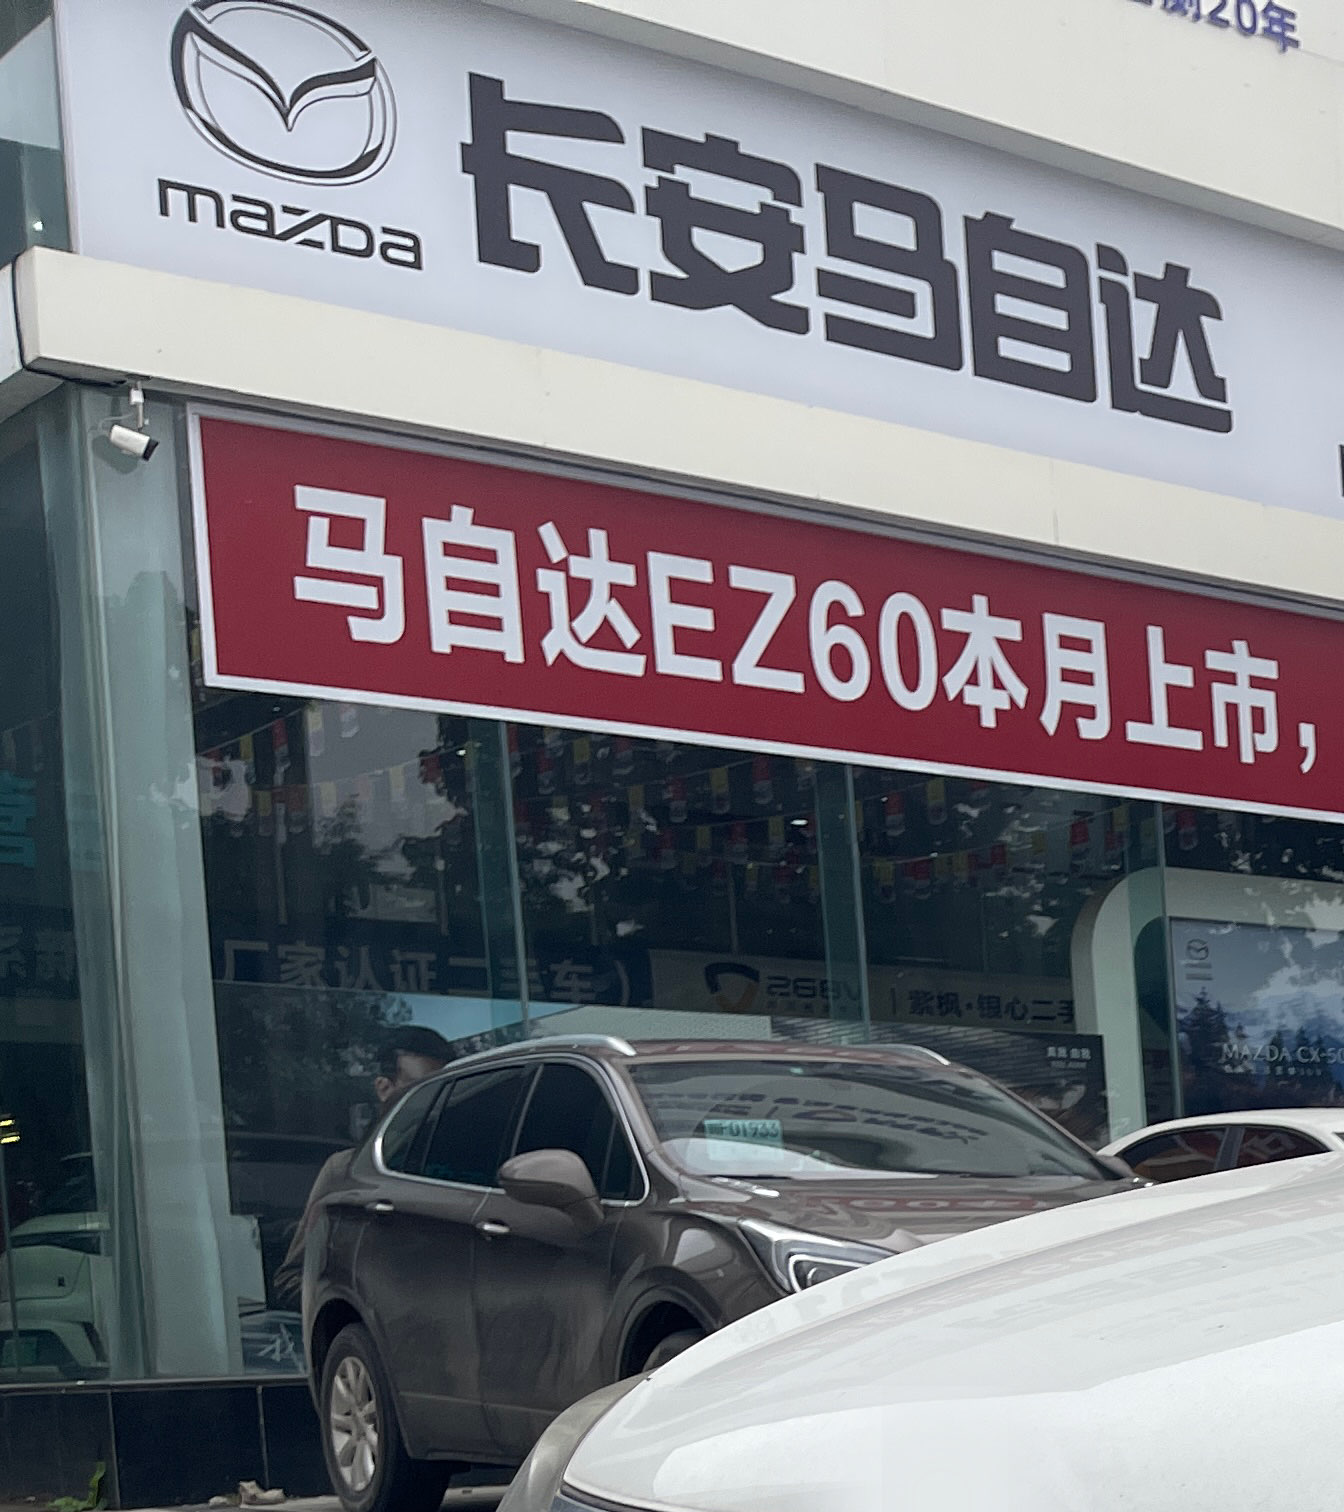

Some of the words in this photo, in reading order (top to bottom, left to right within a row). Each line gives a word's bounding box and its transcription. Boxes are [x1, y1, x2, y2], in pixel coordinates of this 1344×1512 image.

[460, 71, 1233, 434] 长安马自达
[1220, 1043, 1292, 1063] MAZDA
